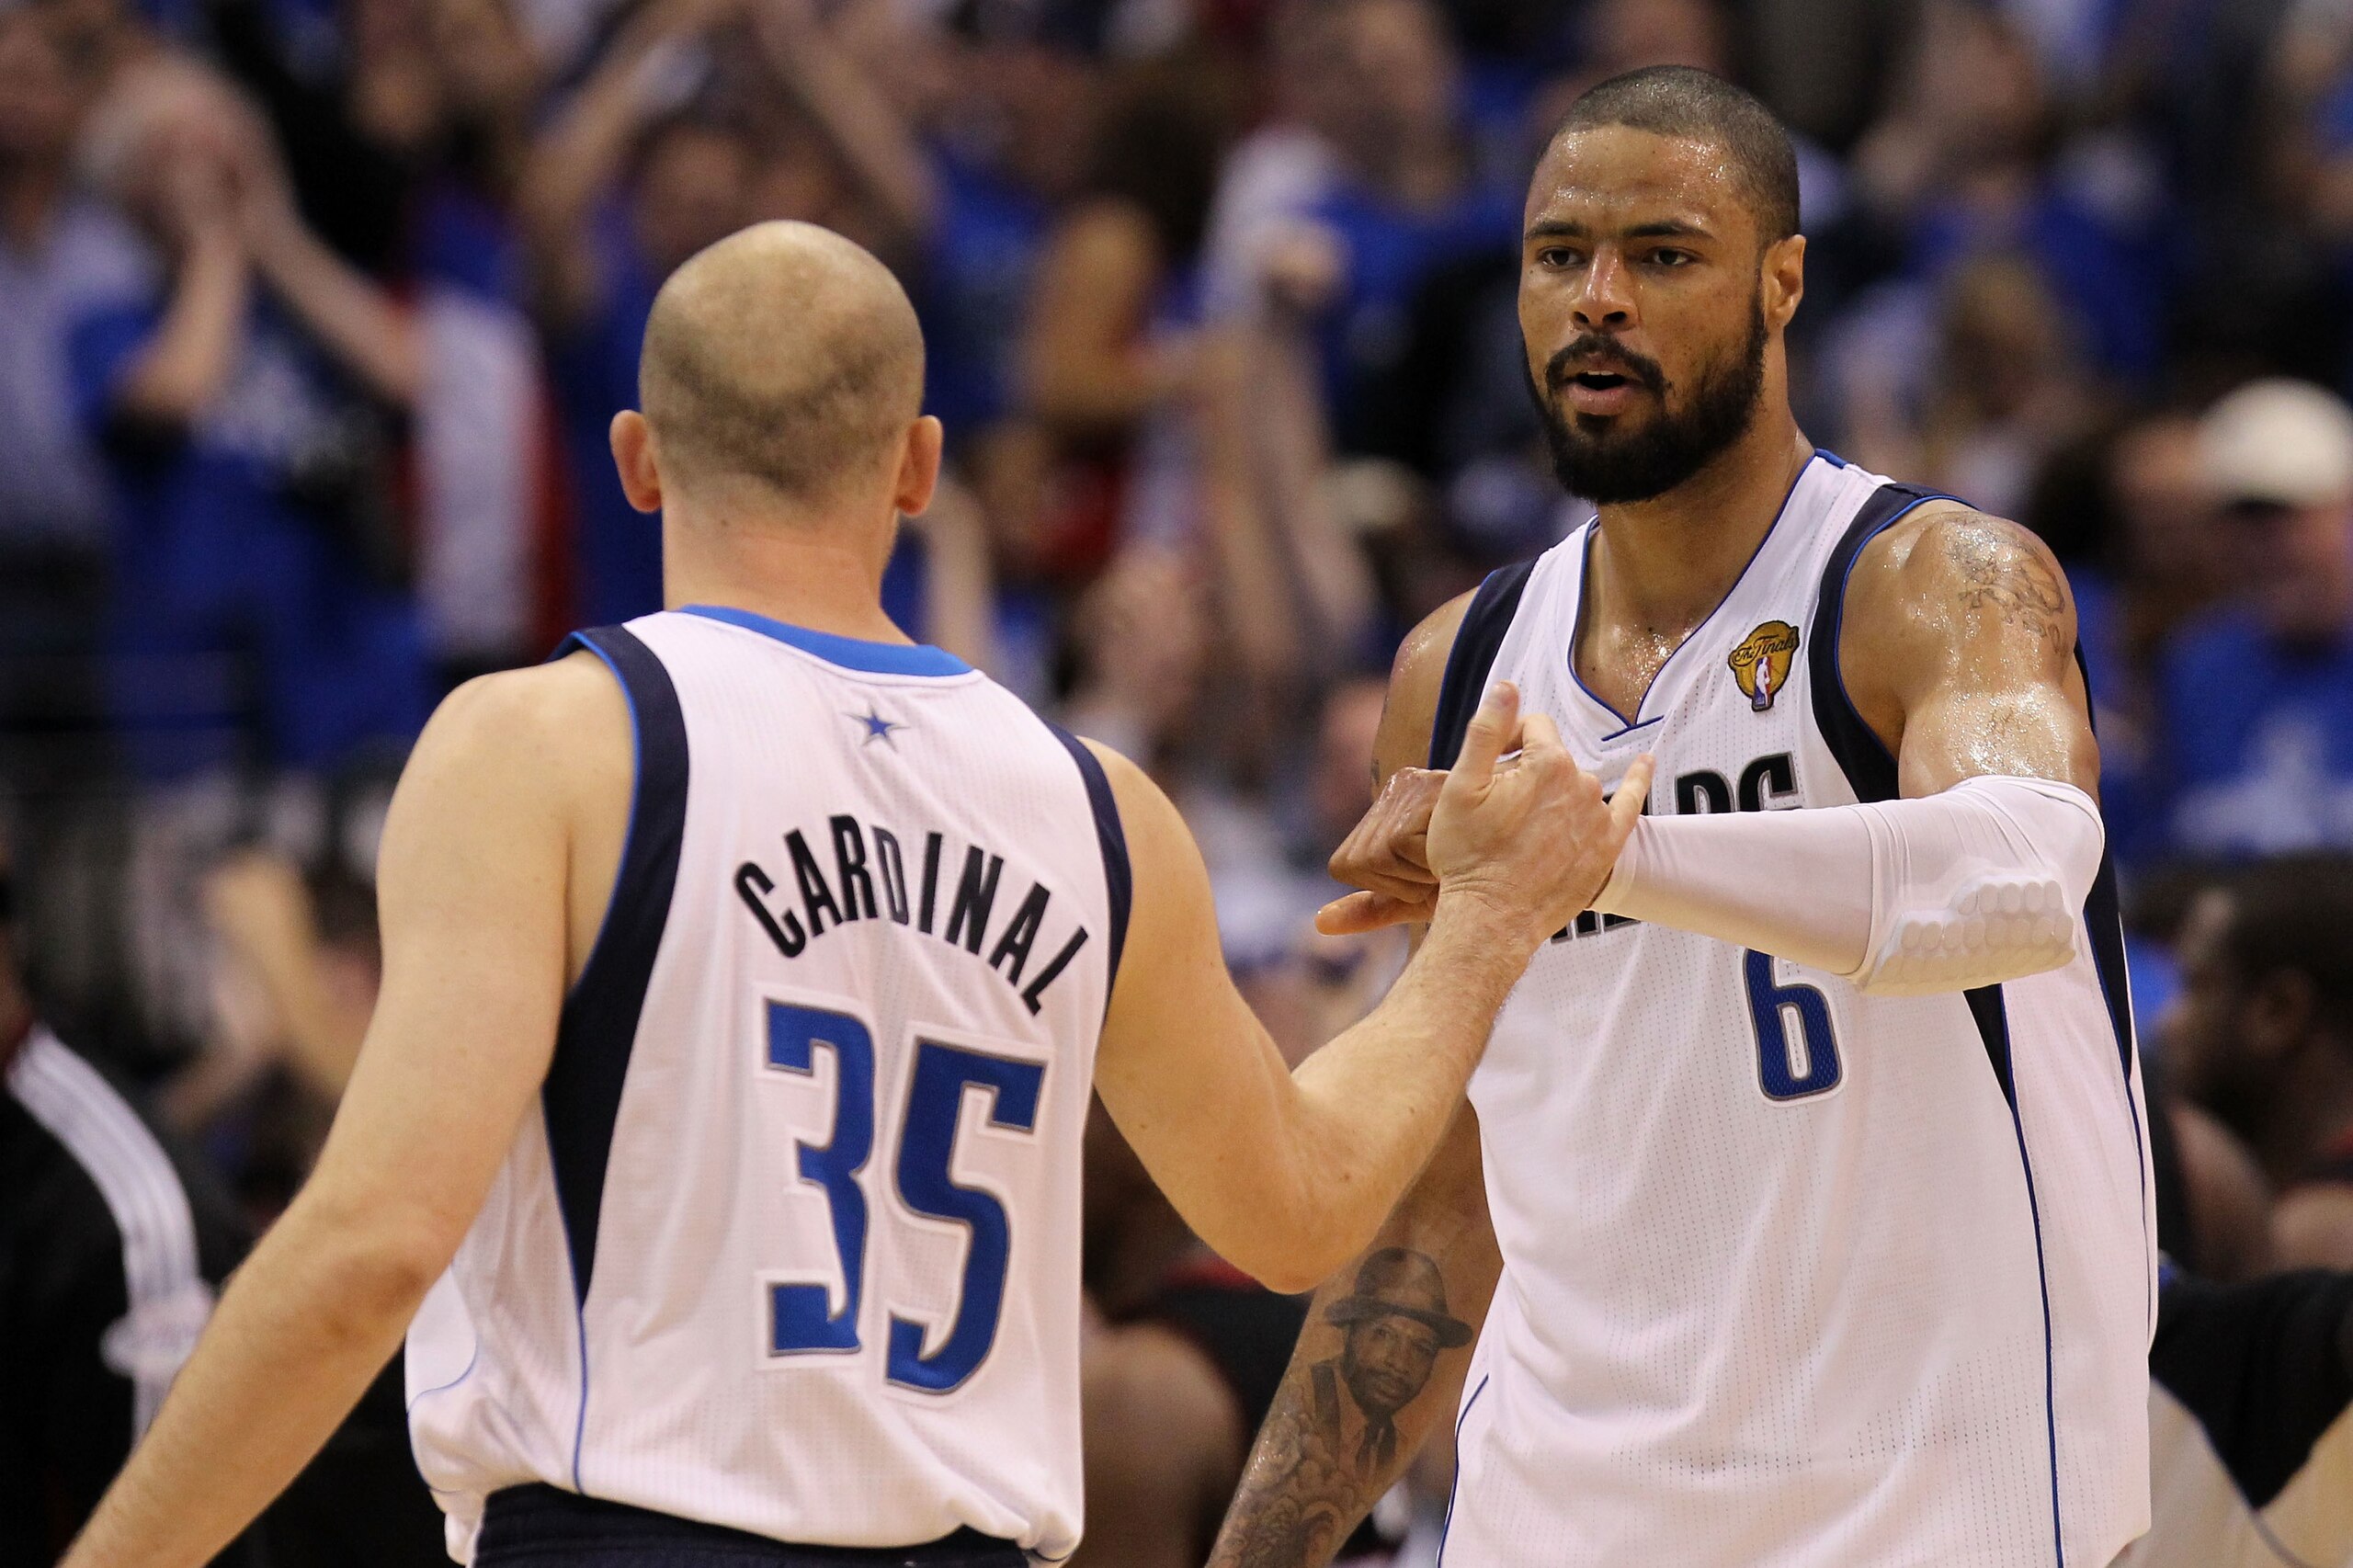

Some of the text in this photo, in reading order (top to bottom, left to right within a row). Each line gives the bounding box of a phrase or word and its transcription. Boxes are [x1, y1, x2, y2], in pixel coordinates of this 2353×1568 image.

[733, 814, 1089, 1017] CARDINAL
[1743, 949, 1843, 1102] 6
[764, 996, 1050, 1395] 35
